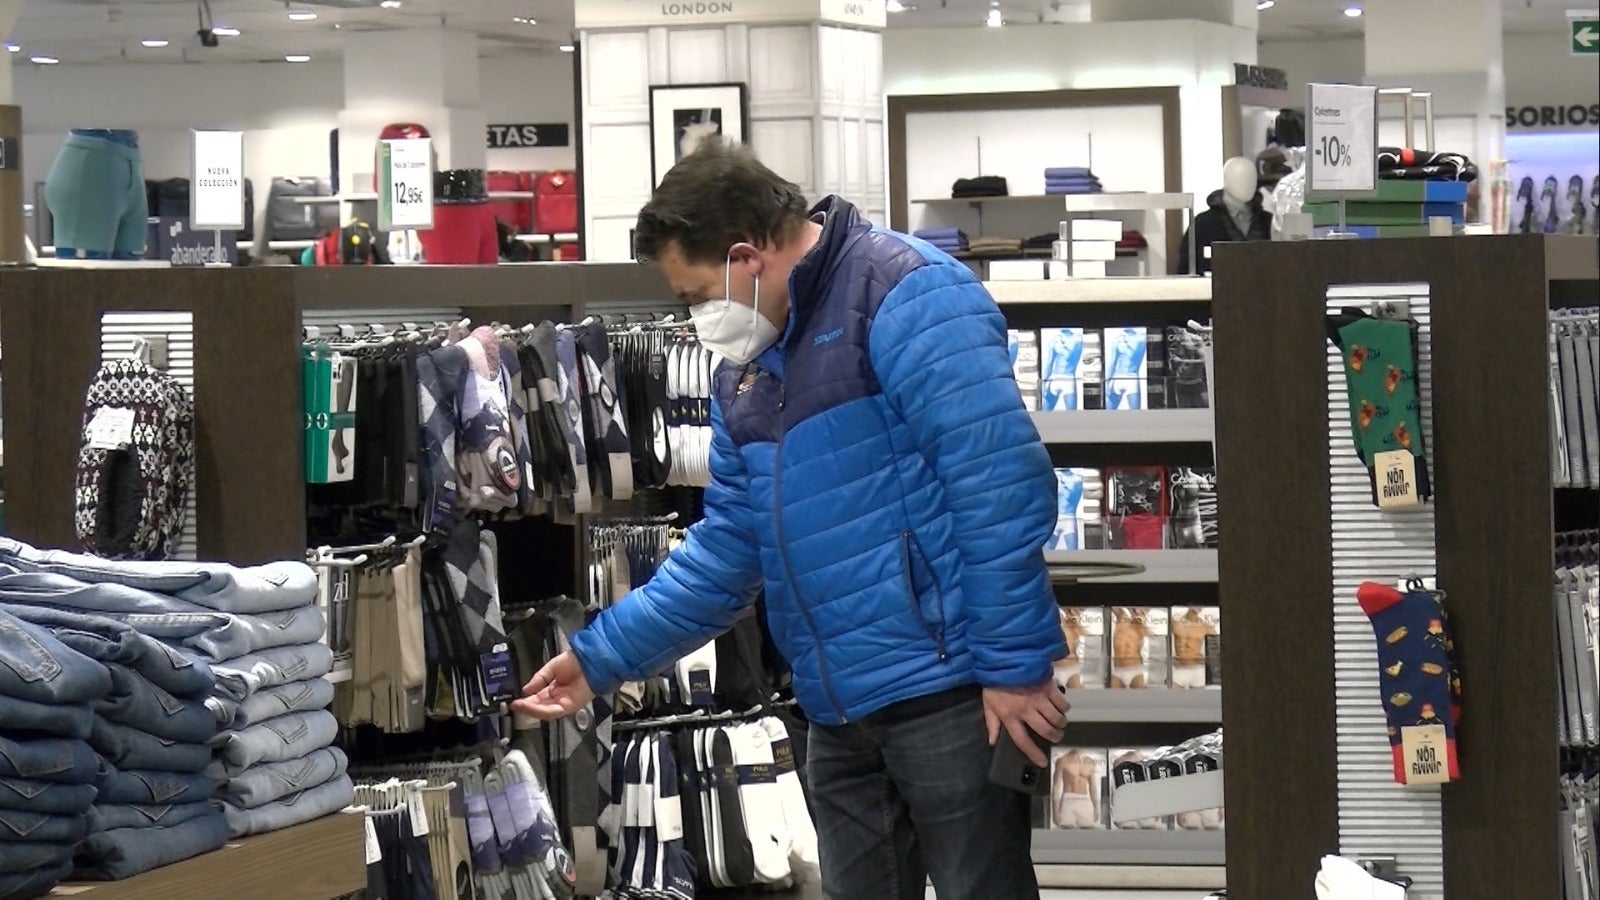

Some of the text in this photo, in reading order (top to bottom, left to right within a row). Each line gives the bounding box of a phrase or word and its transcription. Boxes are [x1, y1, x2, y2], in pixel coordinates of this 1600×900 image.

[662, 2, 732, 15] LONDON
[487, 125, 538, 146] TAS
[1315, 135, 1352, 167] -10%
[395, 182, 423, 206] 12,95€
[171, 243, 228, 265] abanderao
